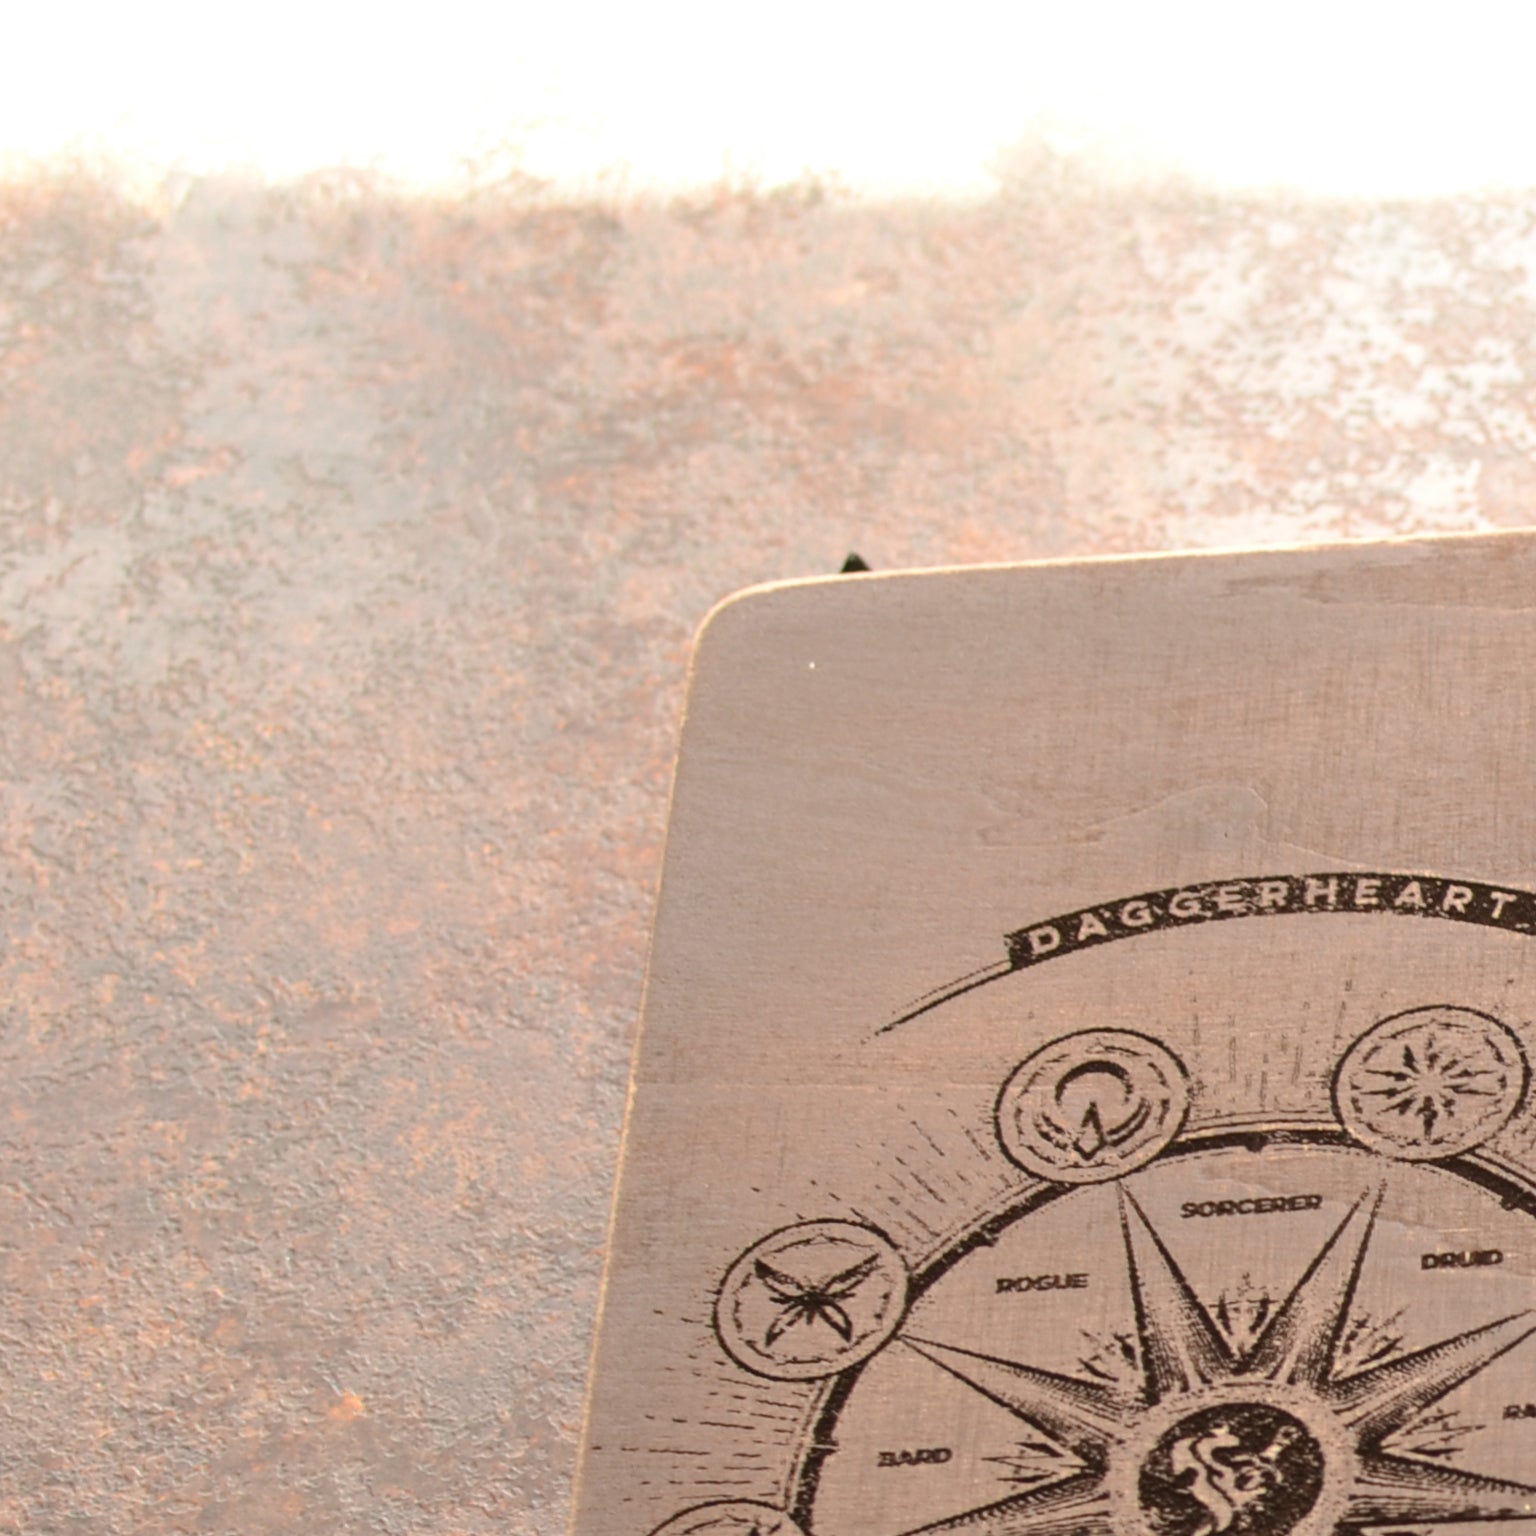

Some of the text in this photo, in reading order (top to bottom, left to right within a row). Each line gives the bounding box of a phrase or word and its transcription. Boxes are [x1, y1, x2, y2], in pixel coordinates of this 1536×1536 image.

[1027, 881, 1519, 960] DAGGERHEART
[1180, 1194, 1322, 1219] SORCERER
[1421, 1247, 1502, 1270] DRUID
[996, 1269, 1090, 1294] ROGUE
